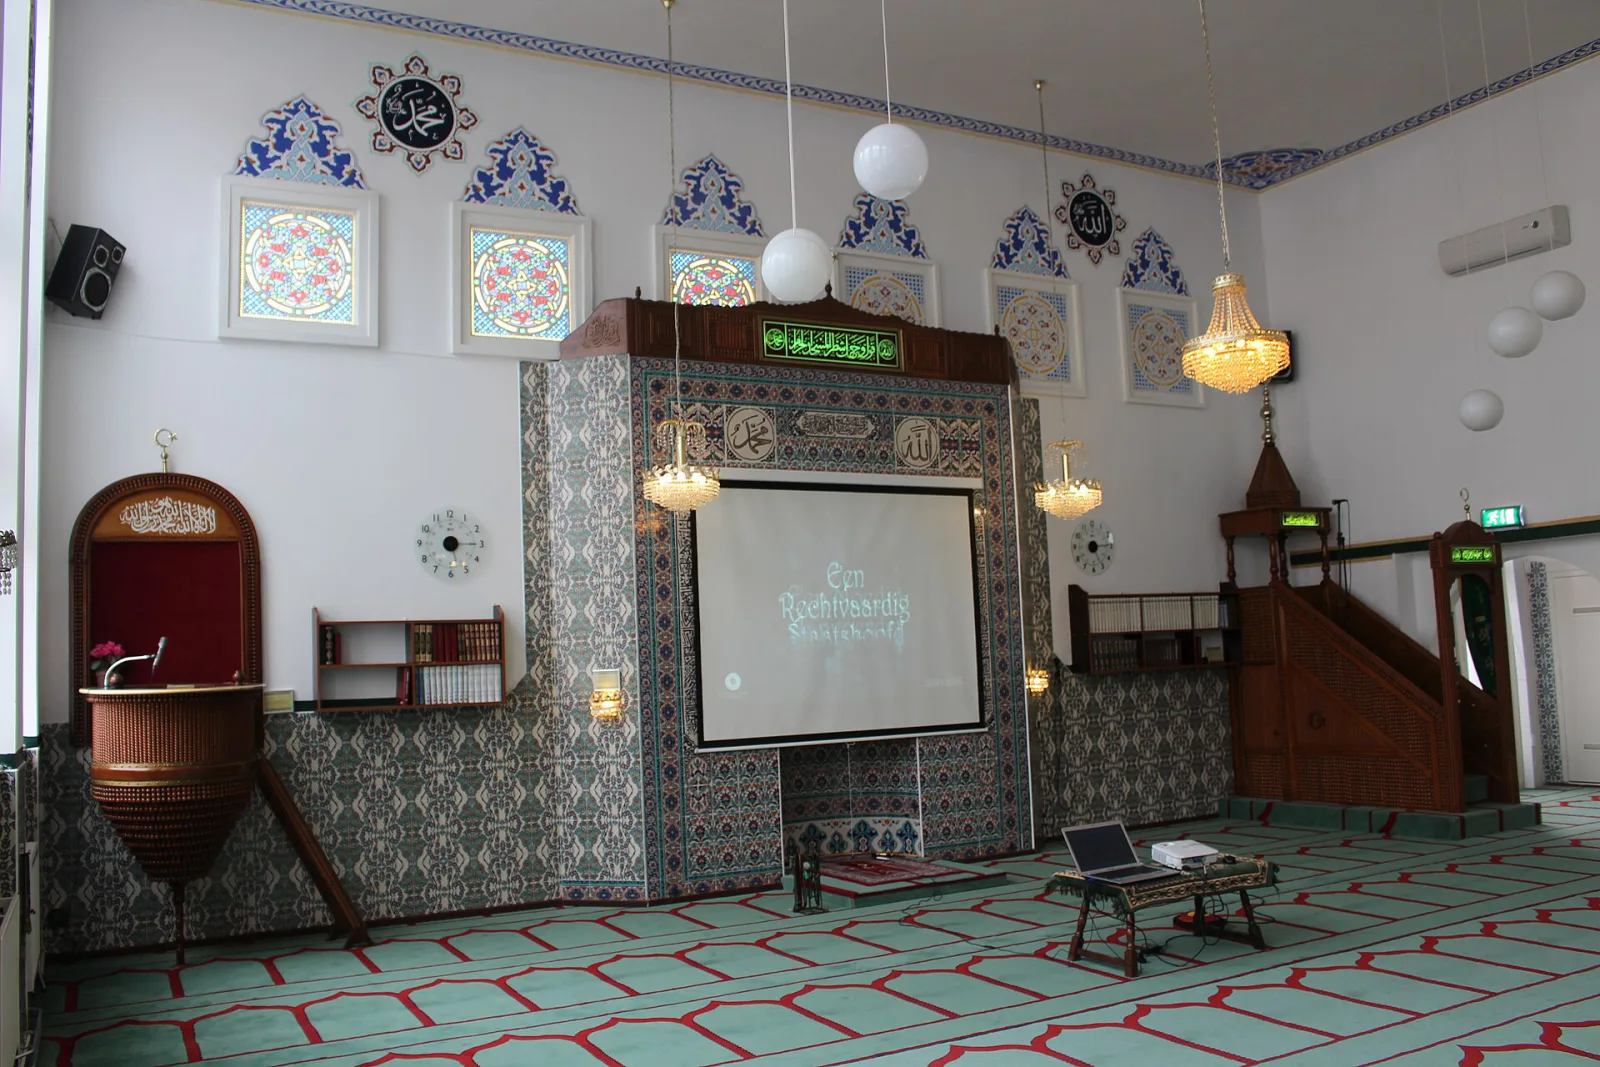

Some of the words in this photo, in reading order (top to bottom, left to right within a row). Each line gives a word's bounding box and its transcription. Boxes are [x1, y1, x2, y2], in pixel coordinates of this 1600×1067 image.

[1074, 201, 1107, 234] الله
[730, 414, 772, 455] محمد
[901, 420, 932, 461] الله
[826, 561, 865, 591] Een
[778, 590, 911, 623] Rechtvaardig
